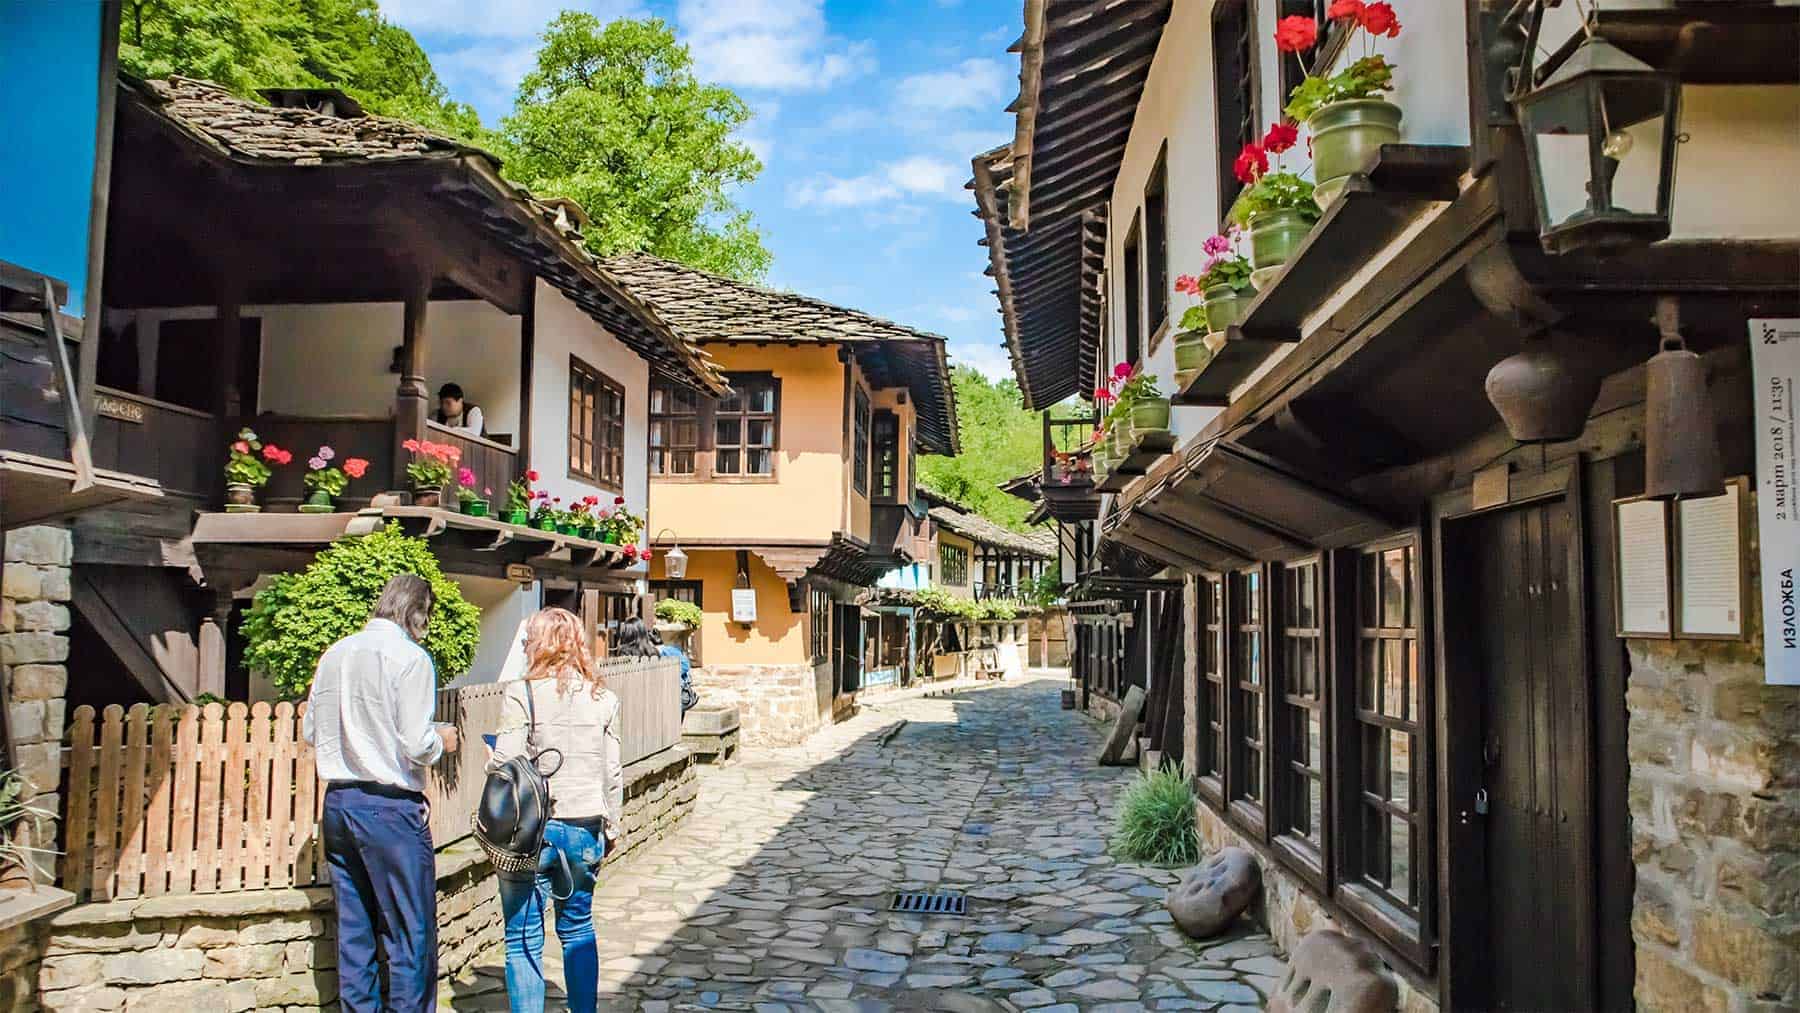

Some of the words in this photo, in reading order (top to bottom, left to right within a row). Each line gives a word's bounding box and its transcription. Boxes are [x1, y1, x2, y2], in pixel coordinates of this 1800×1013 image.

[1770, 376, 1784, 411] 11:30
[1770, 427, 1784, 460] 2018
[1776, 511, 1786, 520] 2
[1780, 568, 1797, 649] ИЗЛОЖБА
